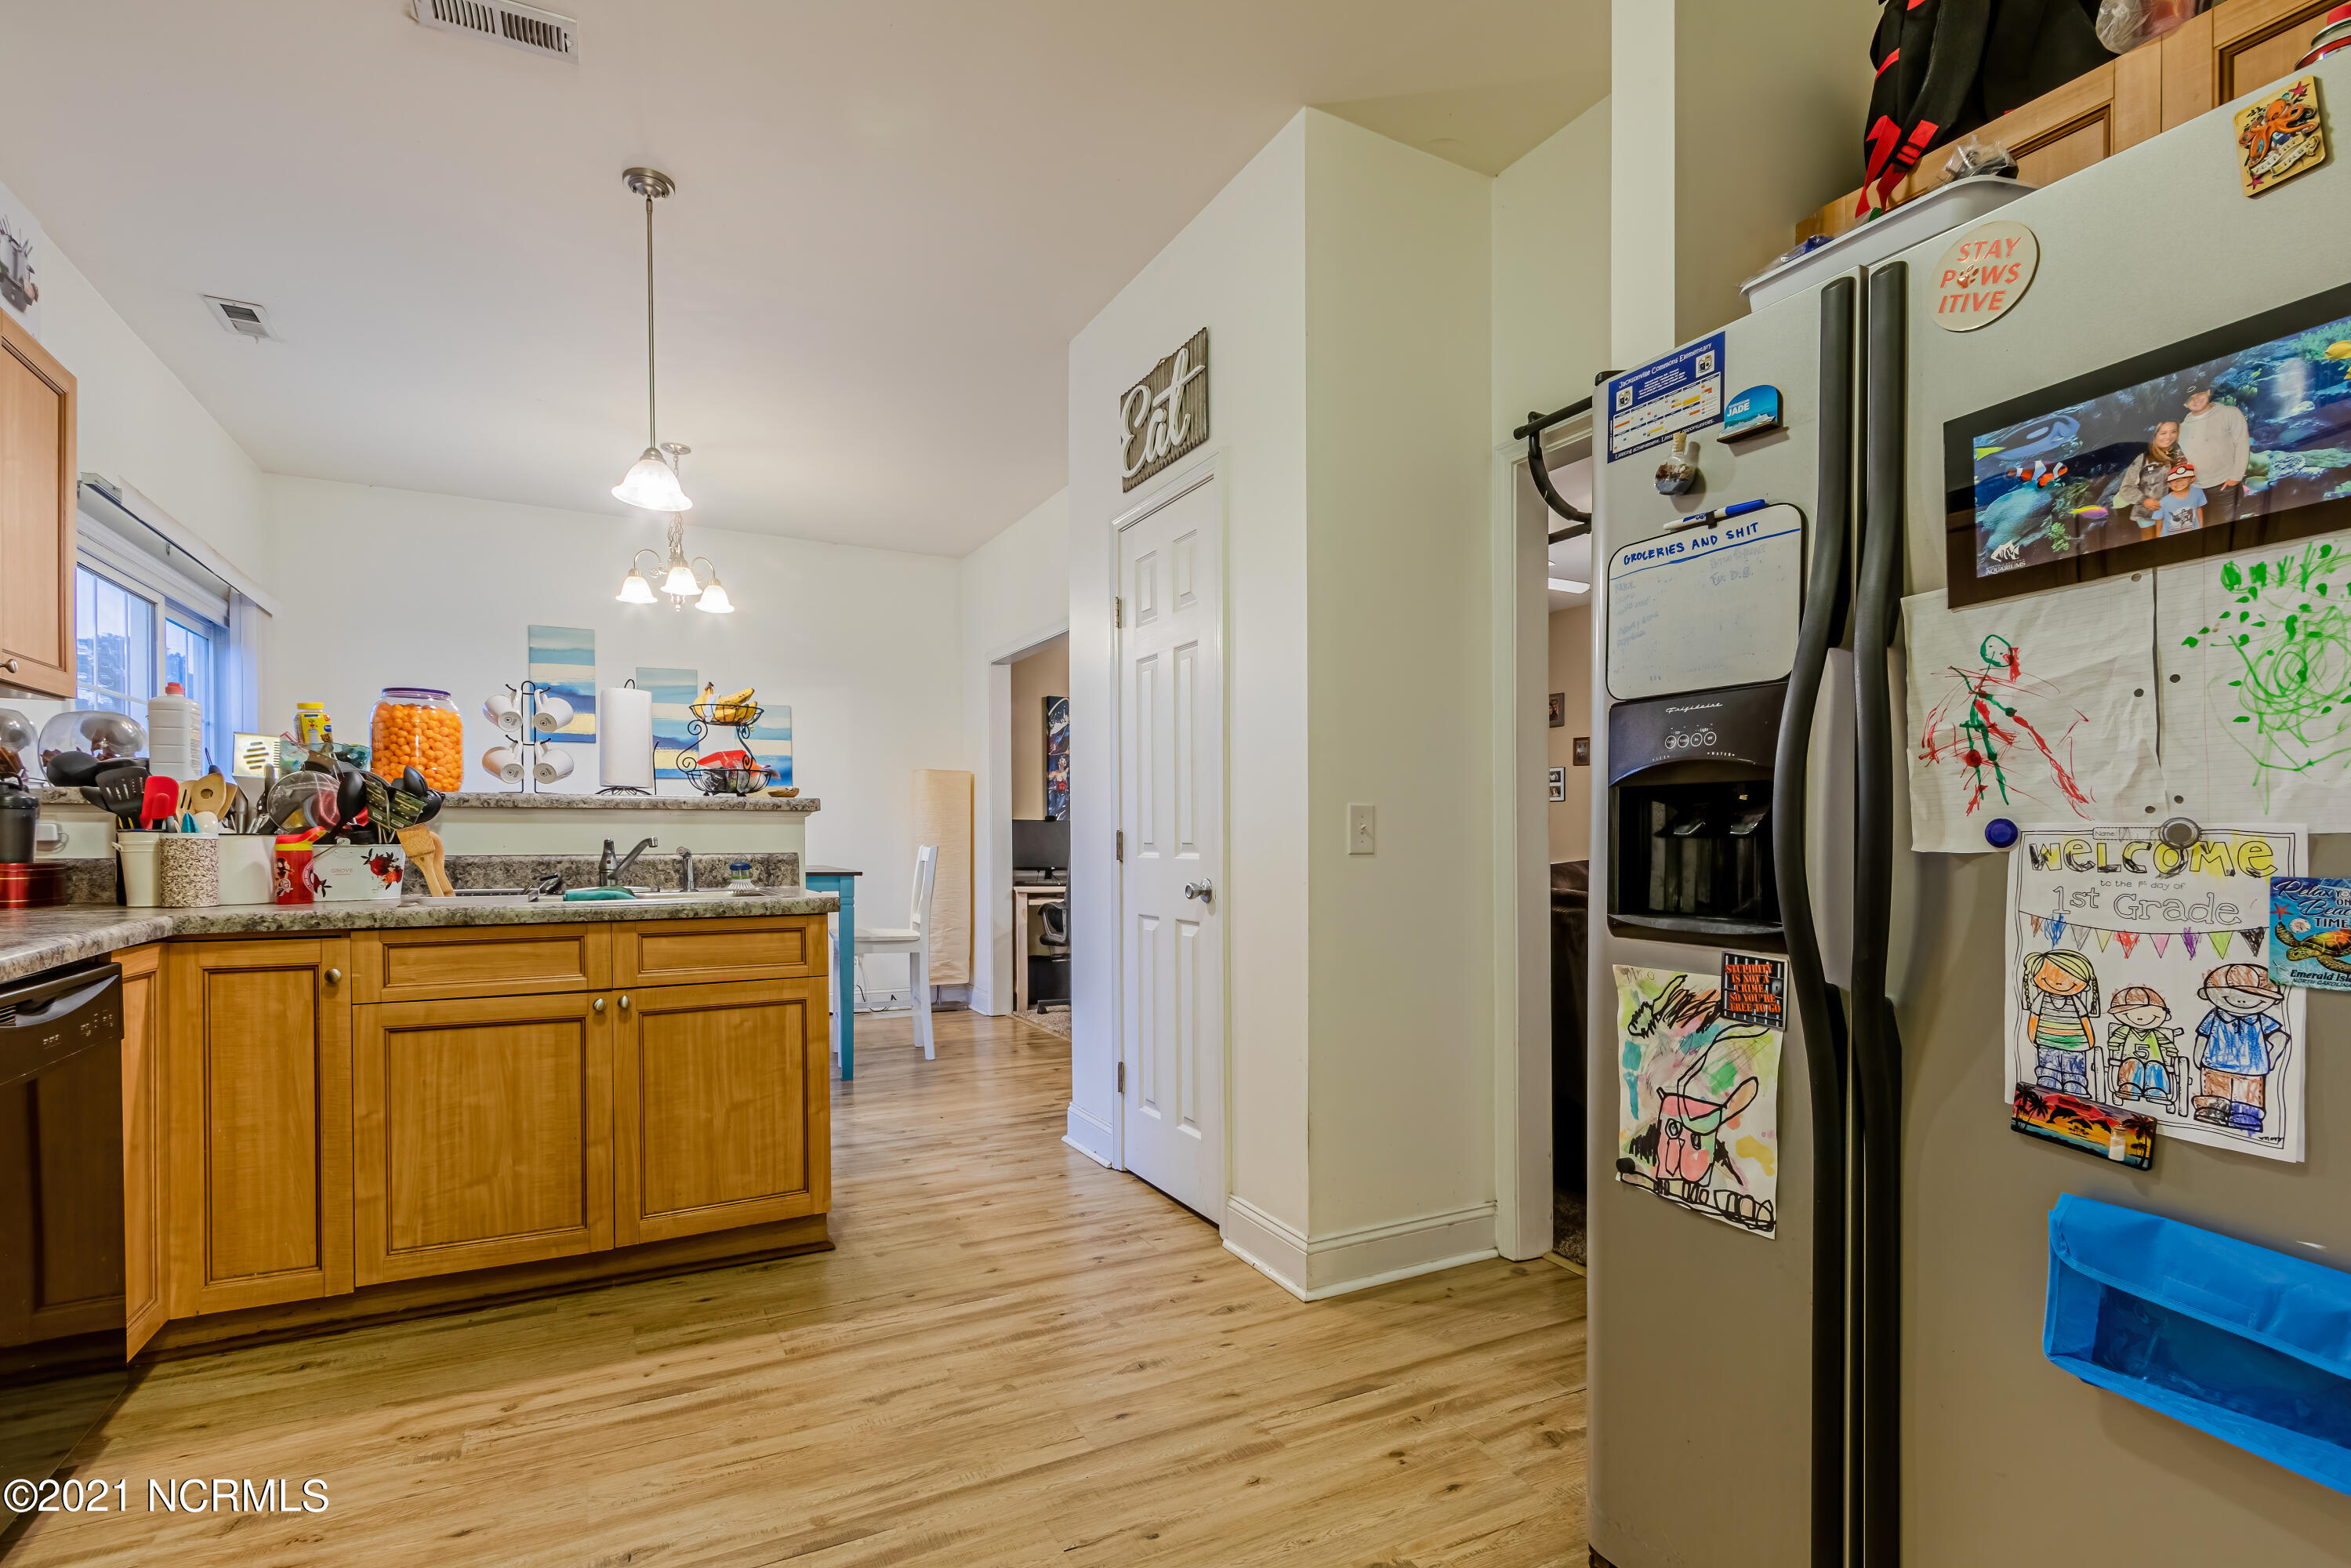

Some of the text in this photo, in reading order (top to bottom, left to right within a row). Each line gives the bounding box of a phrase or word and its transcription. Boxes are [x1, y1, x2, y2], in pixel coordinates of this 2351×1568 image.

[1957, 236, 2022, 262] STAY
[1940, 263, 2021, 289] PWS
[1938, 290, 2007, 314] ITIVE
[1619, 369, 1650, 389] Jacksonville
[1651, 358, 1678, 375] Commons
[1679, 343, 1712, 362] Elementary
[1120, 347, 1206, 478] Eat
[1726, 401, 1750, 417] JADE
[1624, 522, 1758, 565] GROCERIES AND SHIT
[1986, 561, 2026, 575] AQUARIUMS
[1665, 702, 1723, 714] Frigidaire
[2150, 882, 2170, 891] day
[2273, 880, 2334, 901] Relax
[2052, 885, 2243, 925] 1st Grade
[2314, 917, 2349, 928] TIME
[1725, 964, 1772, 974] STUPIDITY
[2291, 970, 2334, 981] Emerald
[1732, 974, 1769, 984] IS NOT A
[1729, 993, 1776, 1003] SO YOU'RE
[1730, 1003, 1781, 1013] FREE TO GO
[2132, 1043, 2151, 1060] 5
